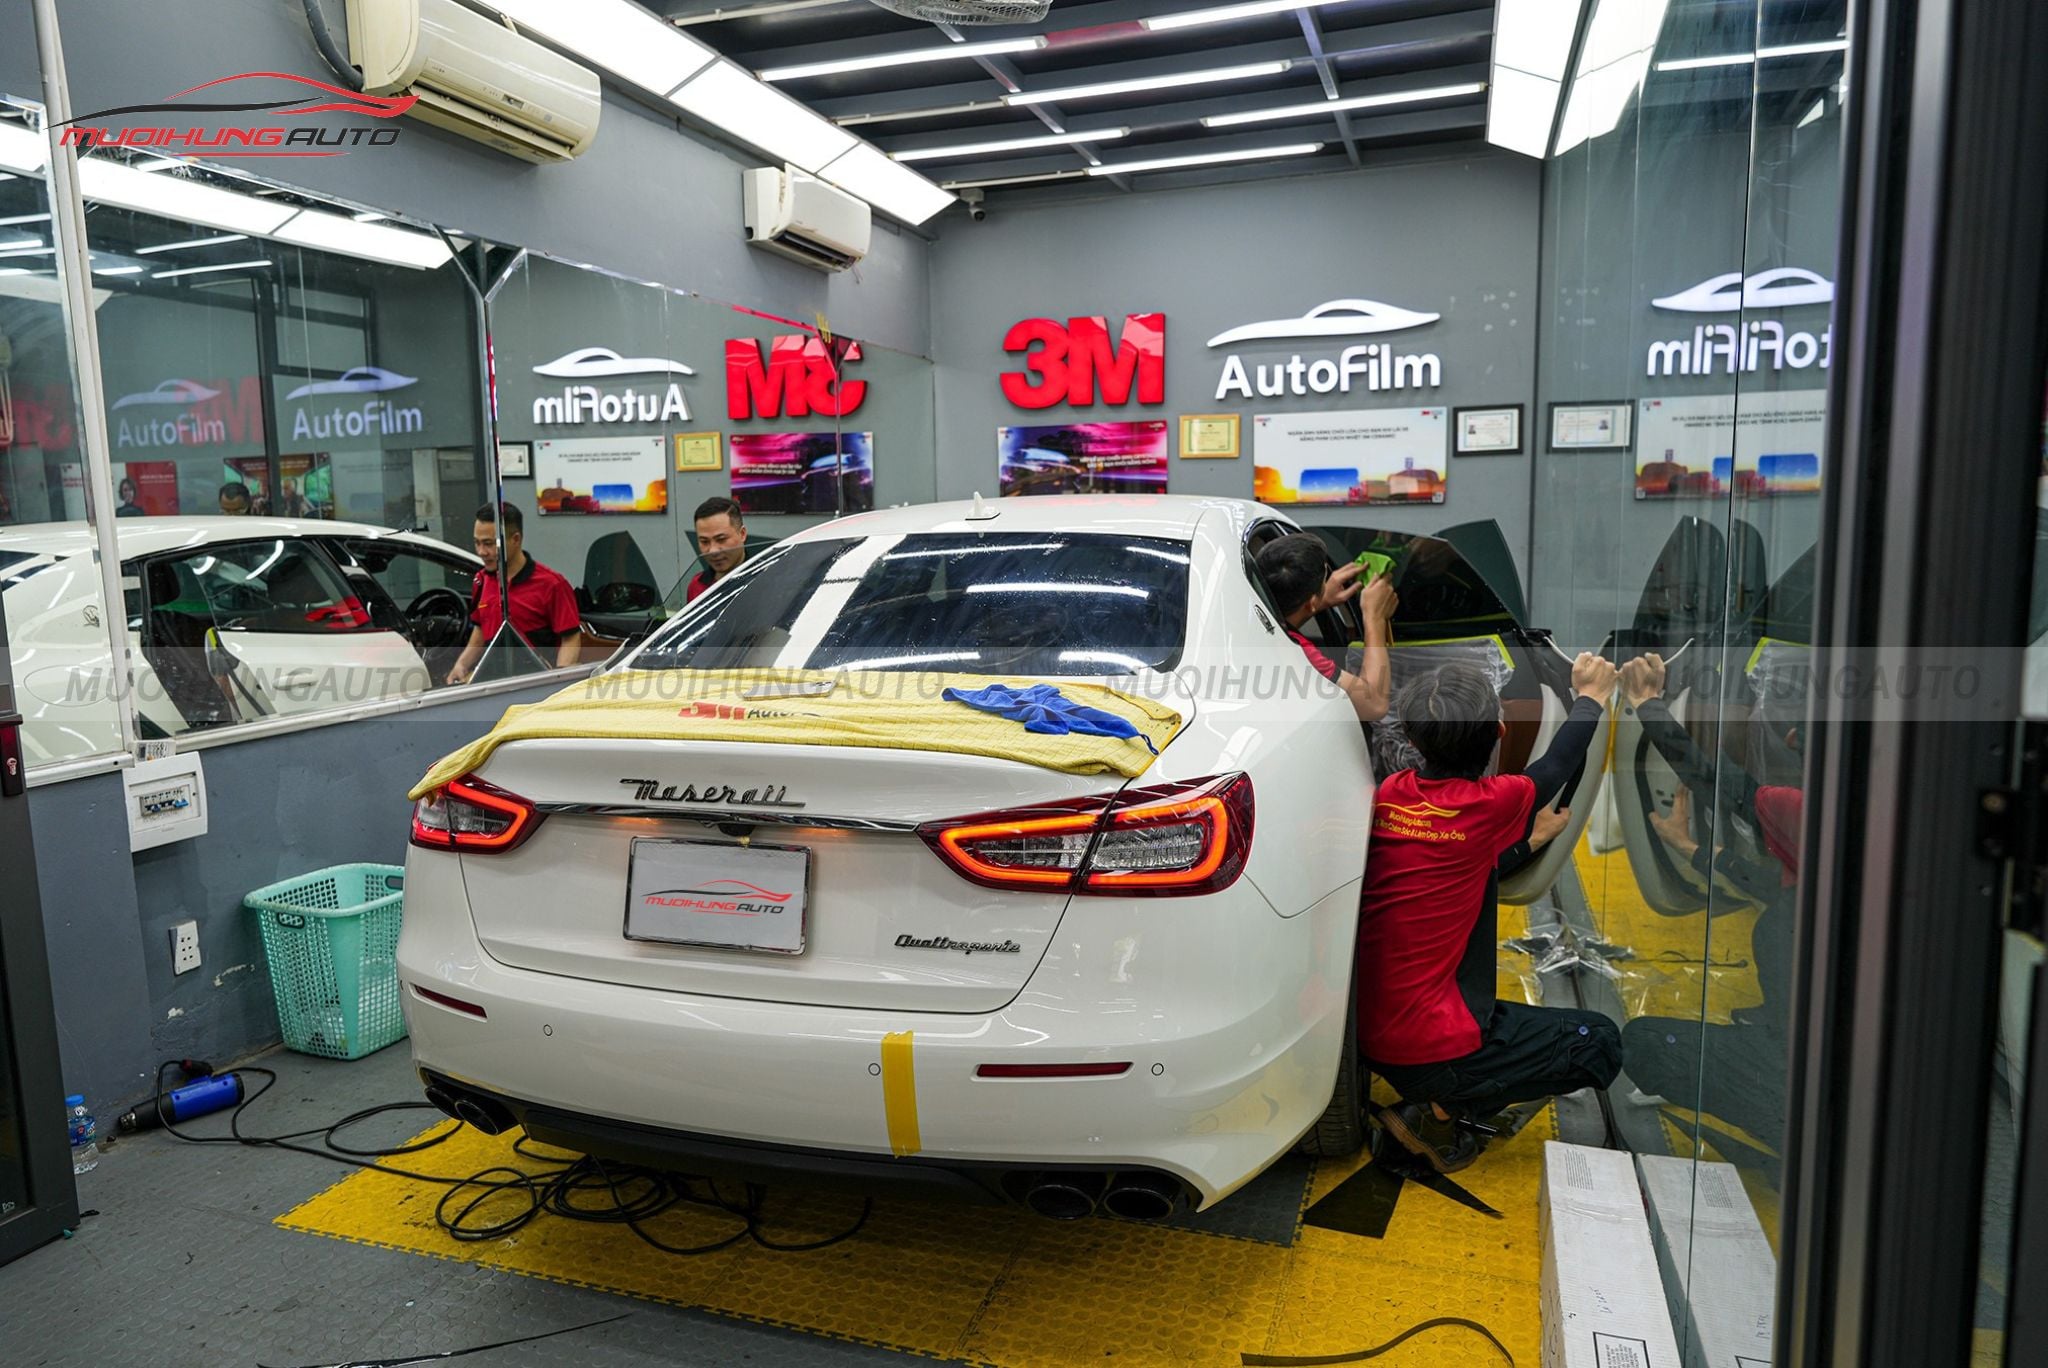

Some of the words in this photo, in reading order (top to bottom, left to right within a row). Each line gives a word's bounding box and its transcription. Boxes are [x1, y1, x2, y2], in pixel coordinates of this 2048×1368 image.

[999, 313, 1165, 409] 3M
[1215, 344, 1441, 401] AutoFilm
[117, 413, 227, 448] AutoFilm
[291, 402, 423, 441] AutoFilm
[620, 779, 805, 807] Maserati
[645, 896, 785, 914] MUOIHUNGAUTO
[894, 934, 1021, 955] Quattroporte
